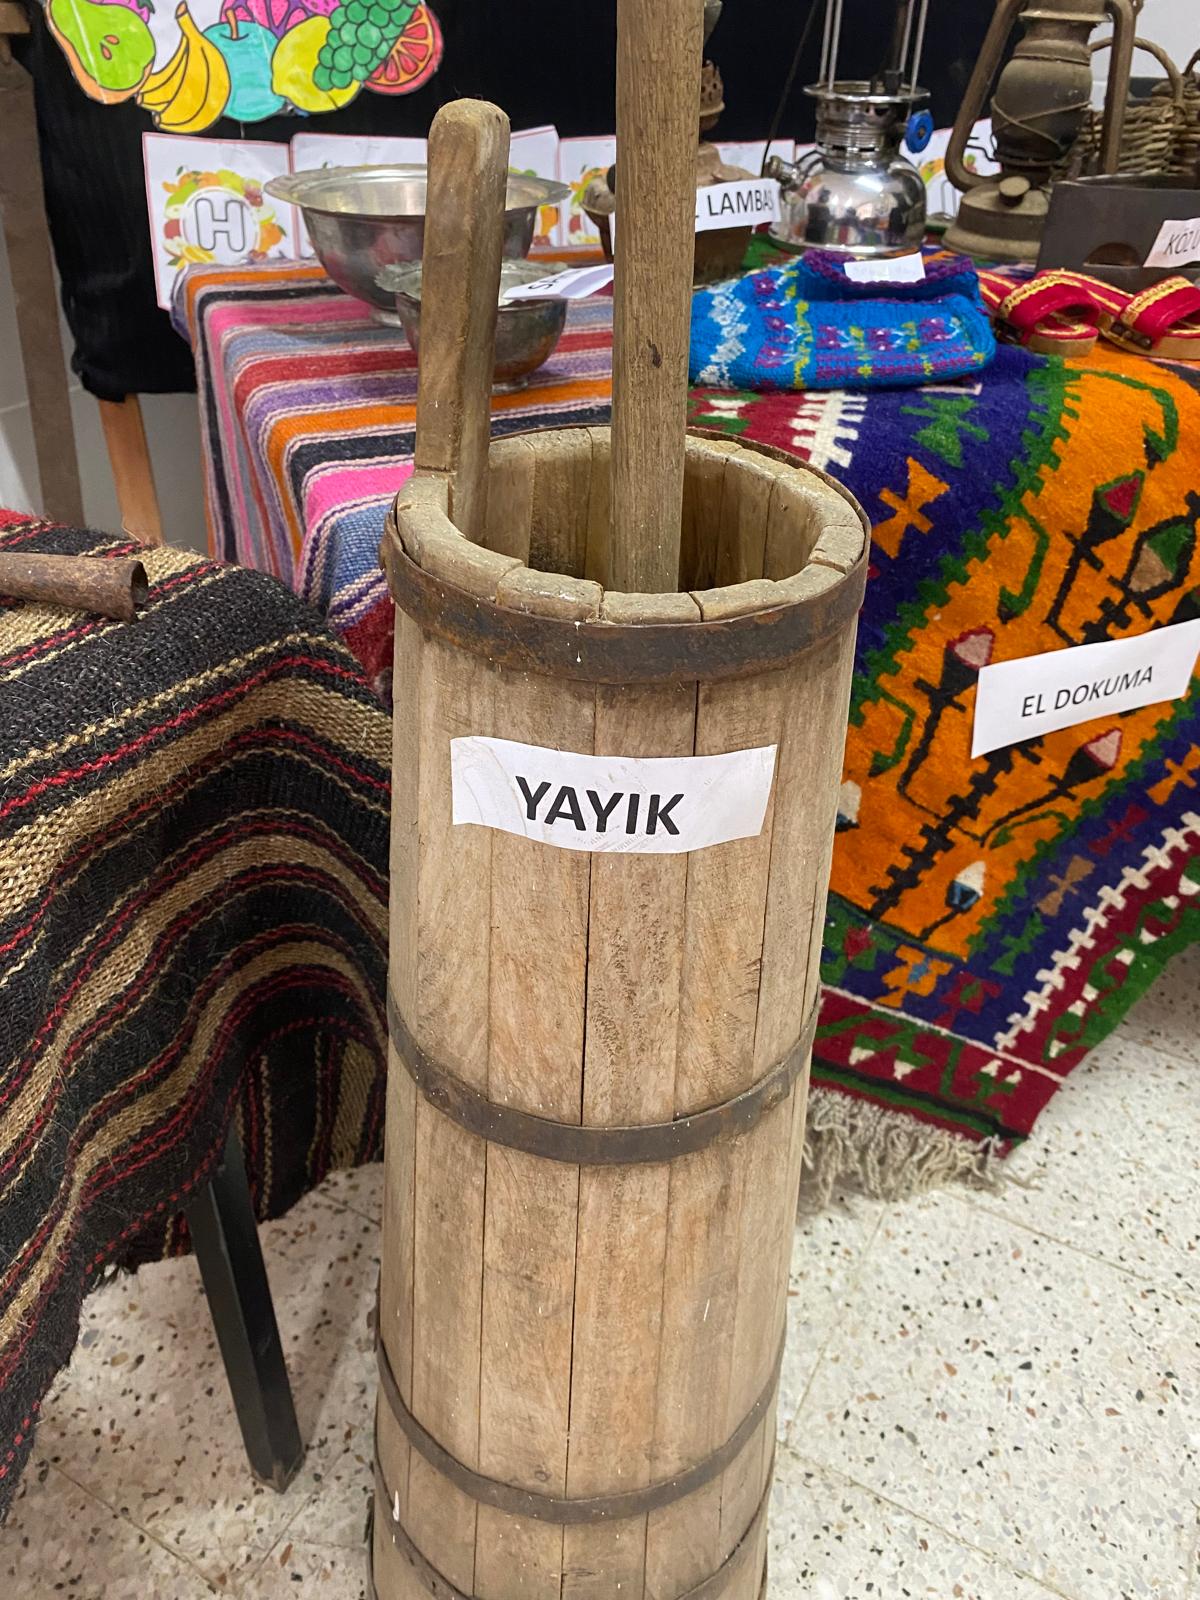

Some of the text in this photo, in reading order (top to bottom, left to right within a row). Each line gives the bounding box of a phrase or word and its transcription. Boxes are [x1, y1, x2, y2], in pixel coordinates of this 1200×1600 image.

[194, 197, 246, 253] H
[1021, 665, 1154, 718] EL DOKUMA
[514, 775, 686, 836] YAYIK
